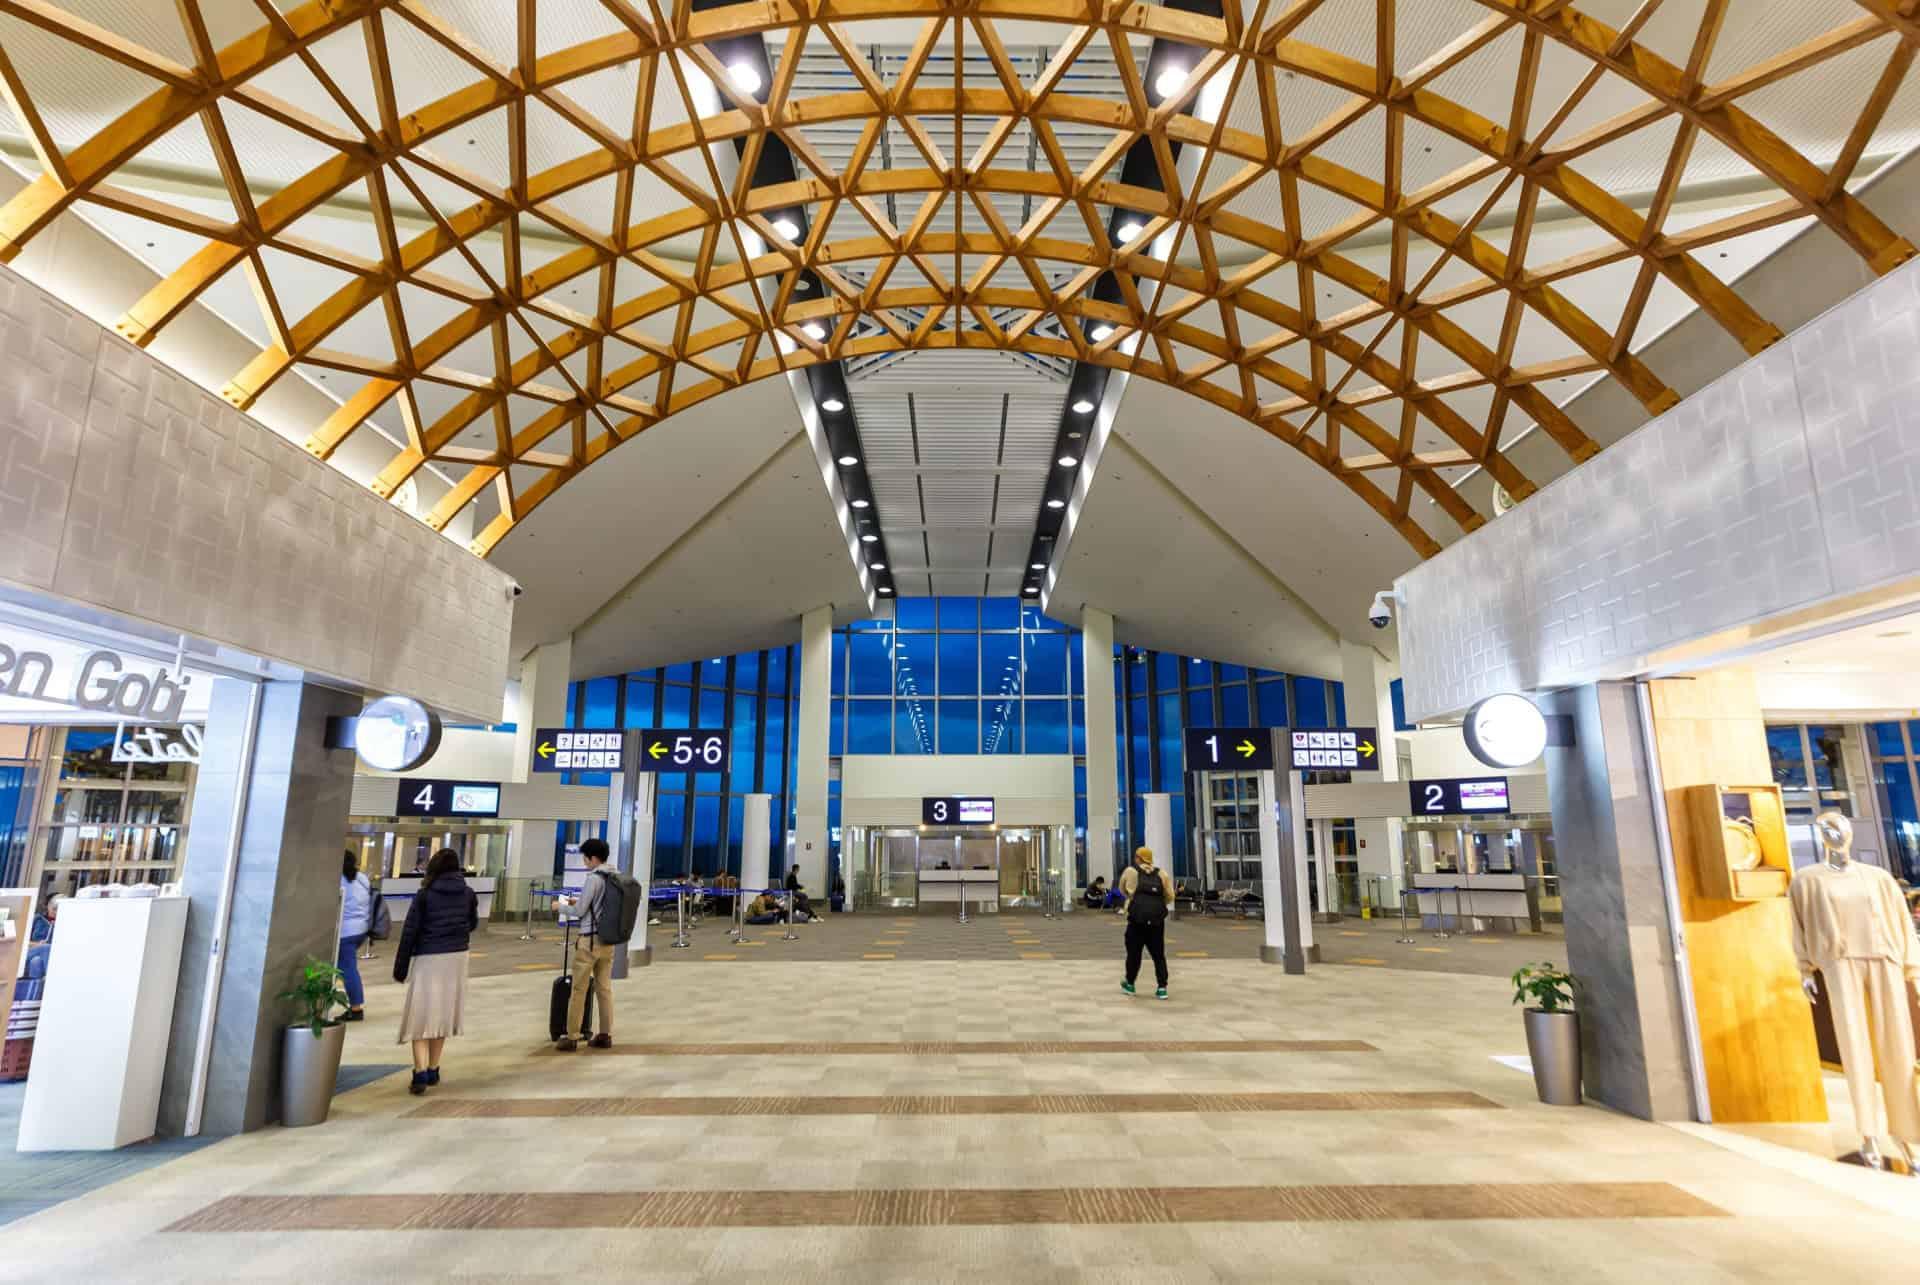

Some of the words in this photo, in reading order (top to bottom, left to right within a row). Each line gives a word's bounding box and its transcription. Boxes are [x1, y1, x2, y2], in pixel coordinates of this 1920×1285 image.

[76, 650, 191, 722] Gobi
[1205, 735, 1218, 763] 1
[413, 784, 434, 811] 4
[933, 801, 947, 821] 3
[1425, 785, 1444, 810] 2
